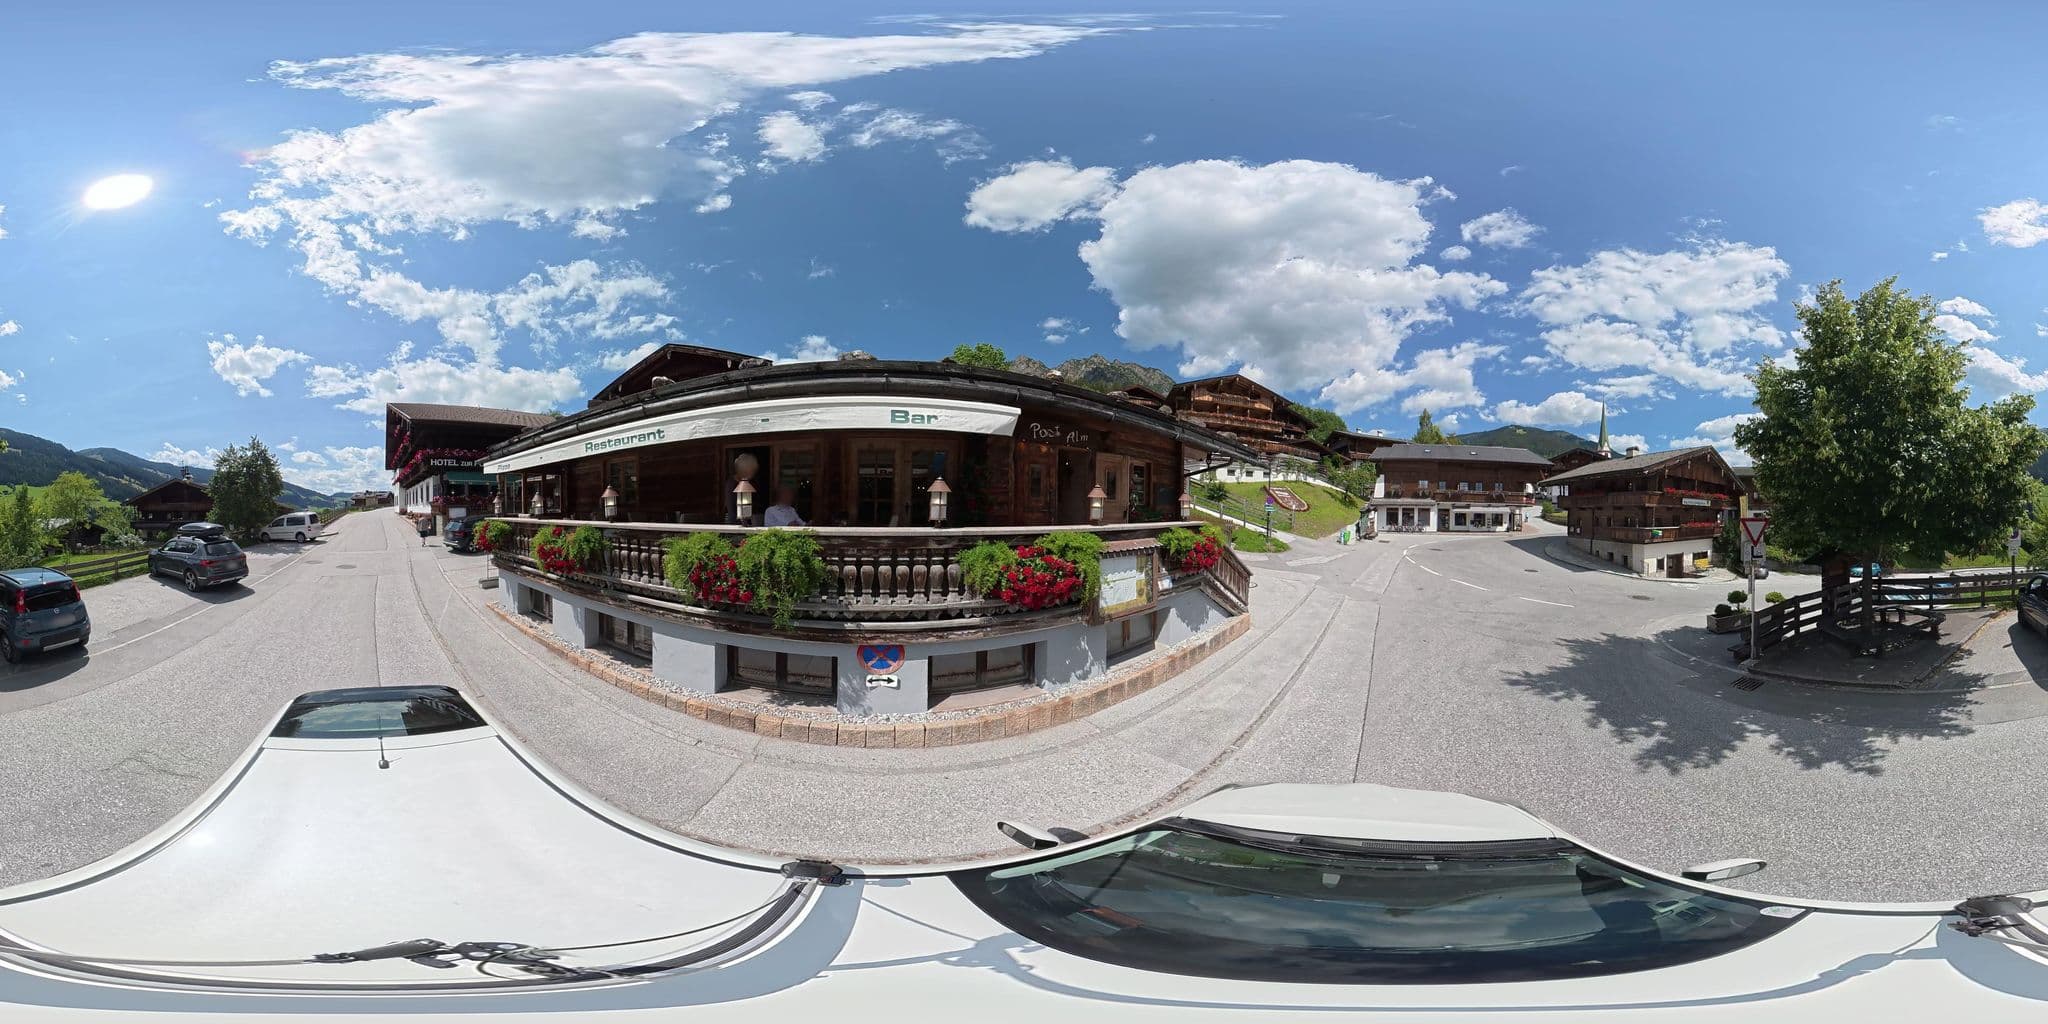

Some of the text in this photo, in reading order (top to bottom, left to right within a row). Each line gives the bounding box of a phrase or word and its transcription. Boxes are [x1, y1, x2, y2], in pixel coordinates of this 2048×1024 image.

[585, 429, 665, 453] Restaurant
[891, 410, 938, 424] Bar
[1066, 430, 1089, 443] Alm
